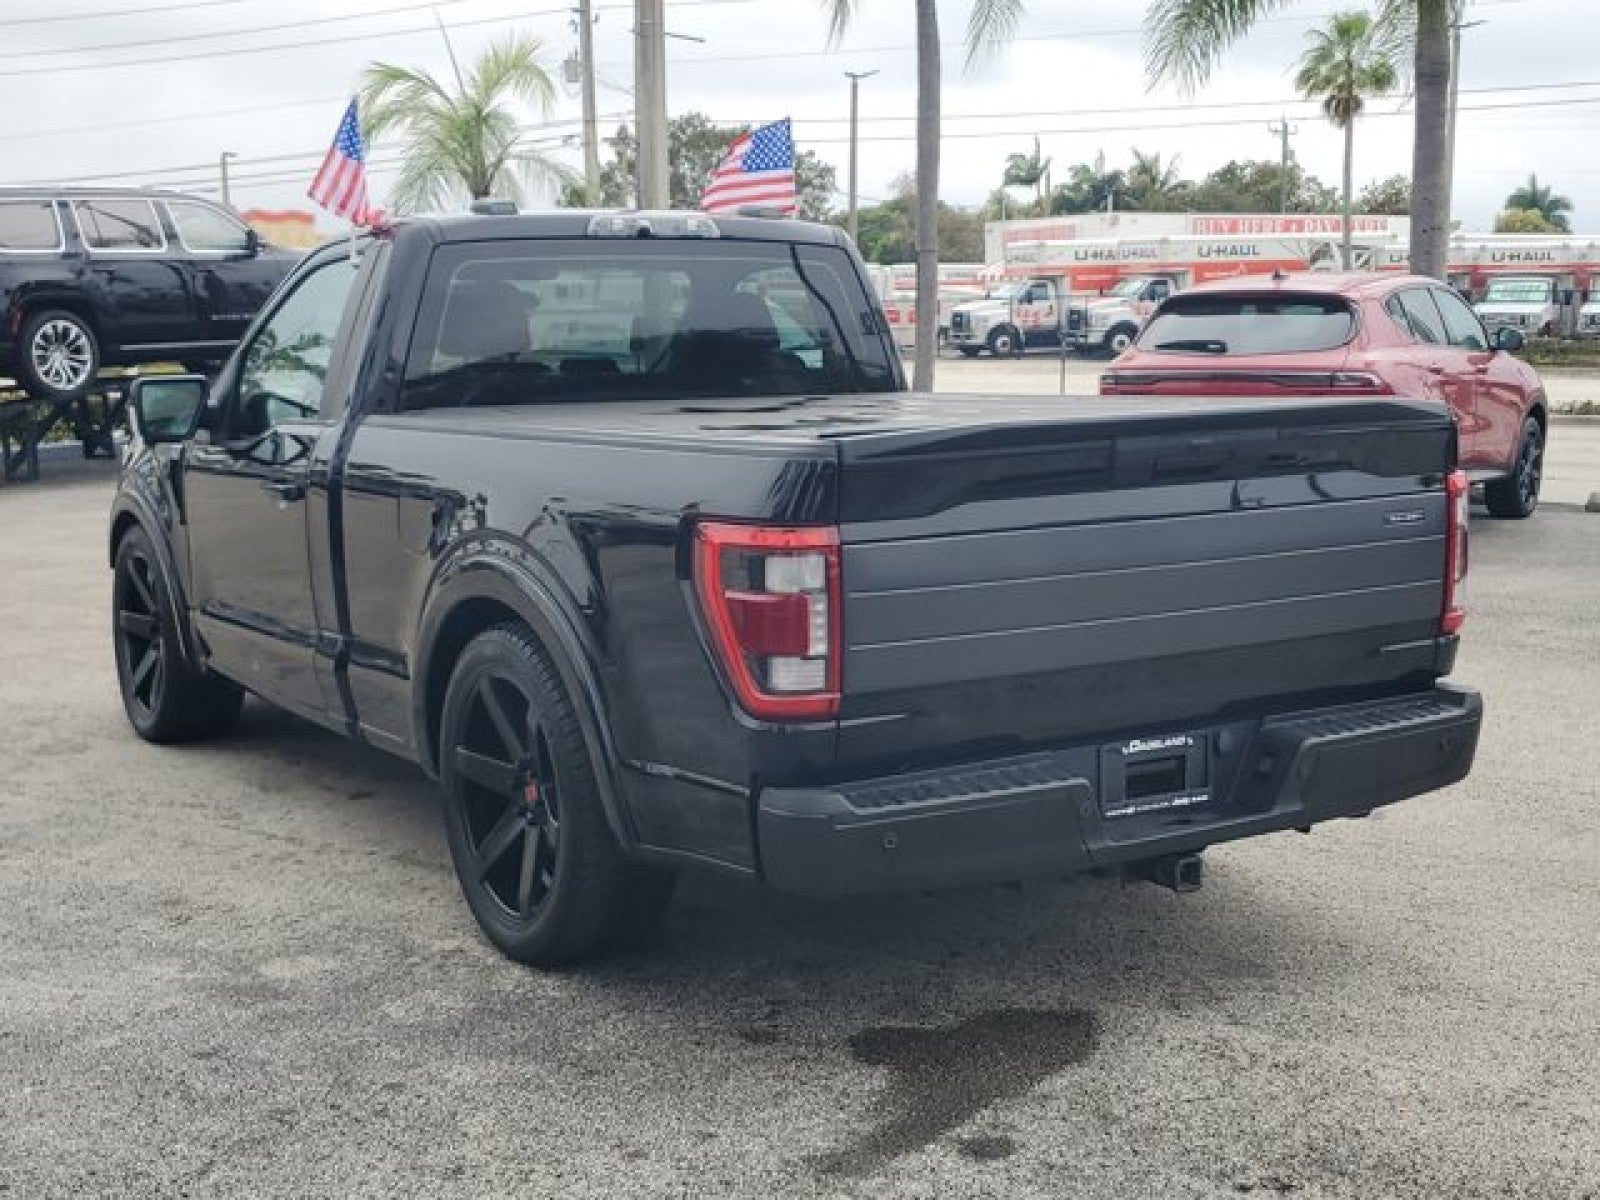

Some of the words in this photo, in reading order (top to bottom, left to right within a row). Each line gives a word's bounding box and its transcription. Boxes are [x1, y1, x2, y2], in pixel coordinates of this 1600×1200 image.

[1074, 249, 1117, 261] U-HA
[1196, 244, 1260, 258] U-HAUL
[1491, 251, 1556, 262] U-HAUL
